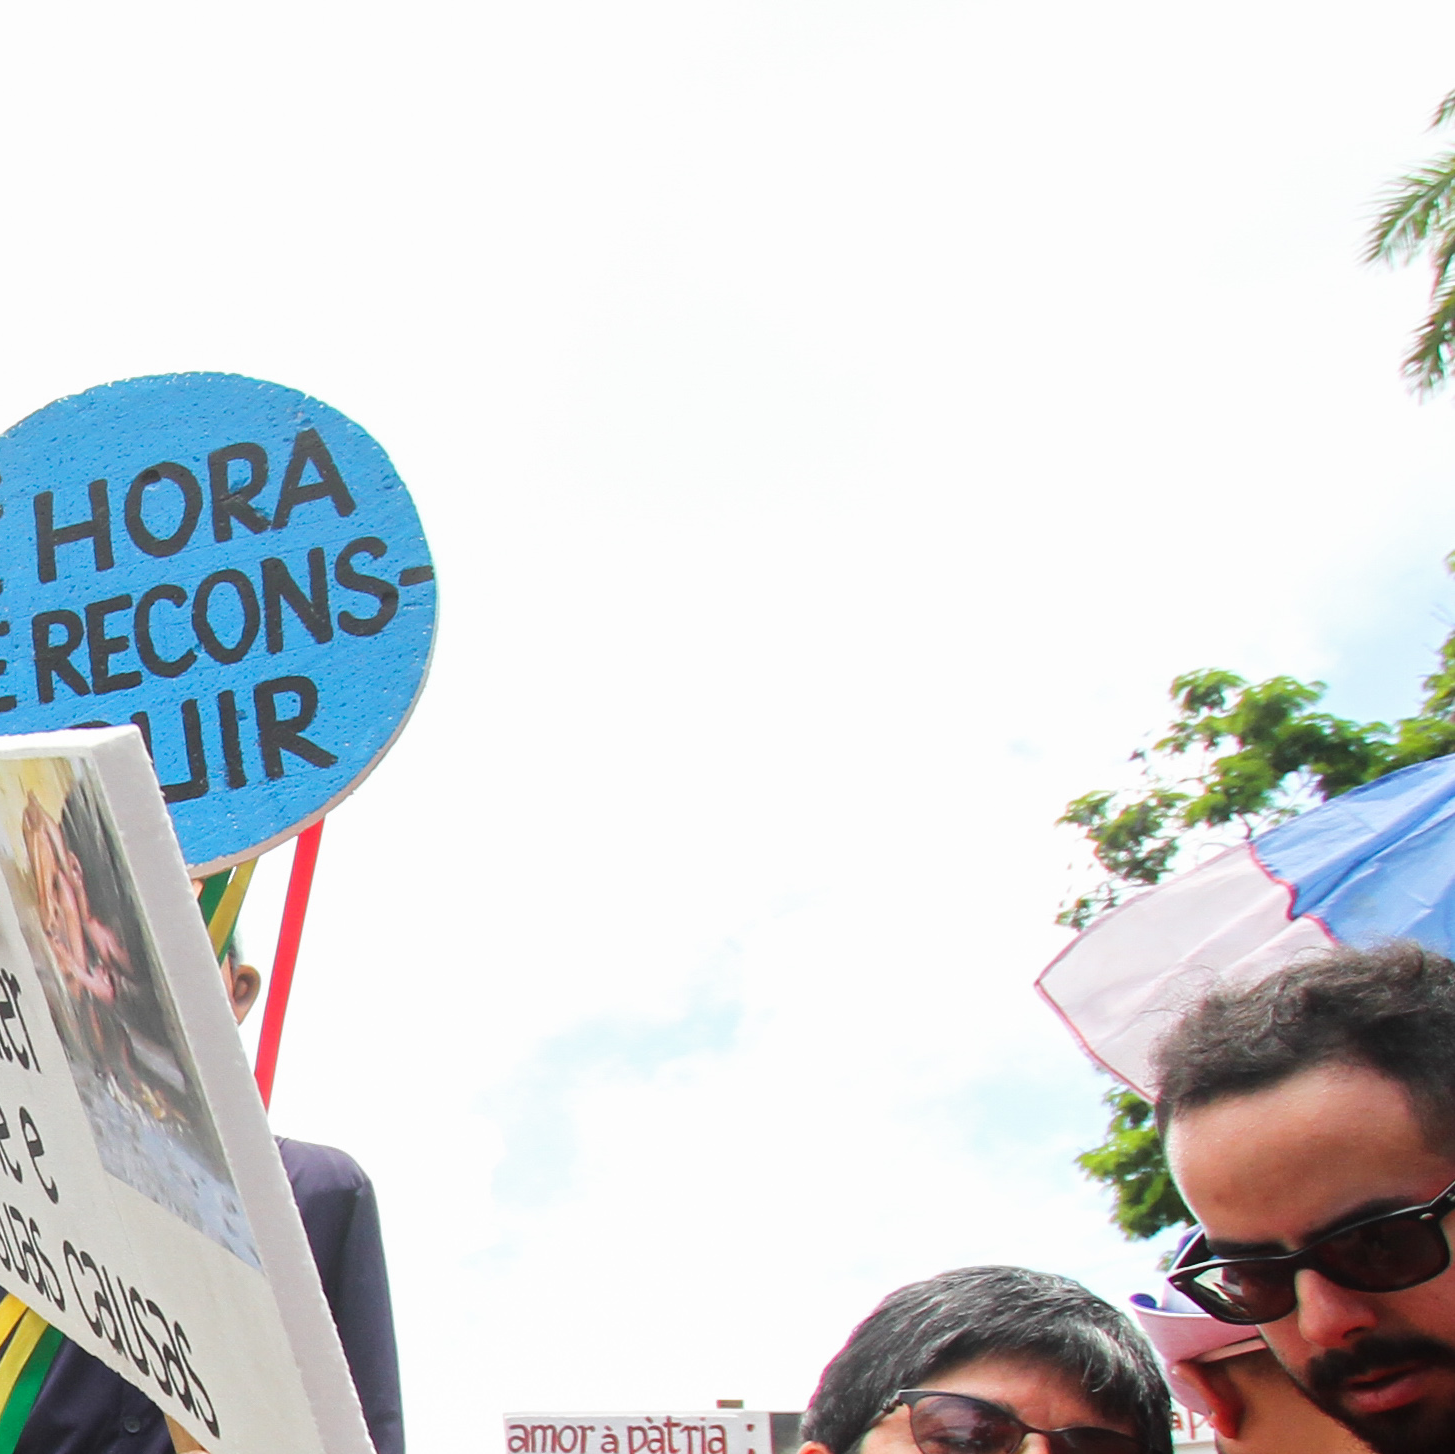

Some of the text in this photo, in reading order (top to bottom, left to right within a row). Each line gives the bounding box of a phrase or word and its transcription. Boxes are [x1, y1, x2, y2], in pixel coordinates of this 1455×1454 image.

[32, 428, 357, 585] HORA
[30, 536, 435, 705] RECONS-
[68, 674, 339, 804] UIR
[19, 1105, 60, 1205] e
[62, 1238, 222, 1439] causas
[507, 1422, 595, 1454] amor
